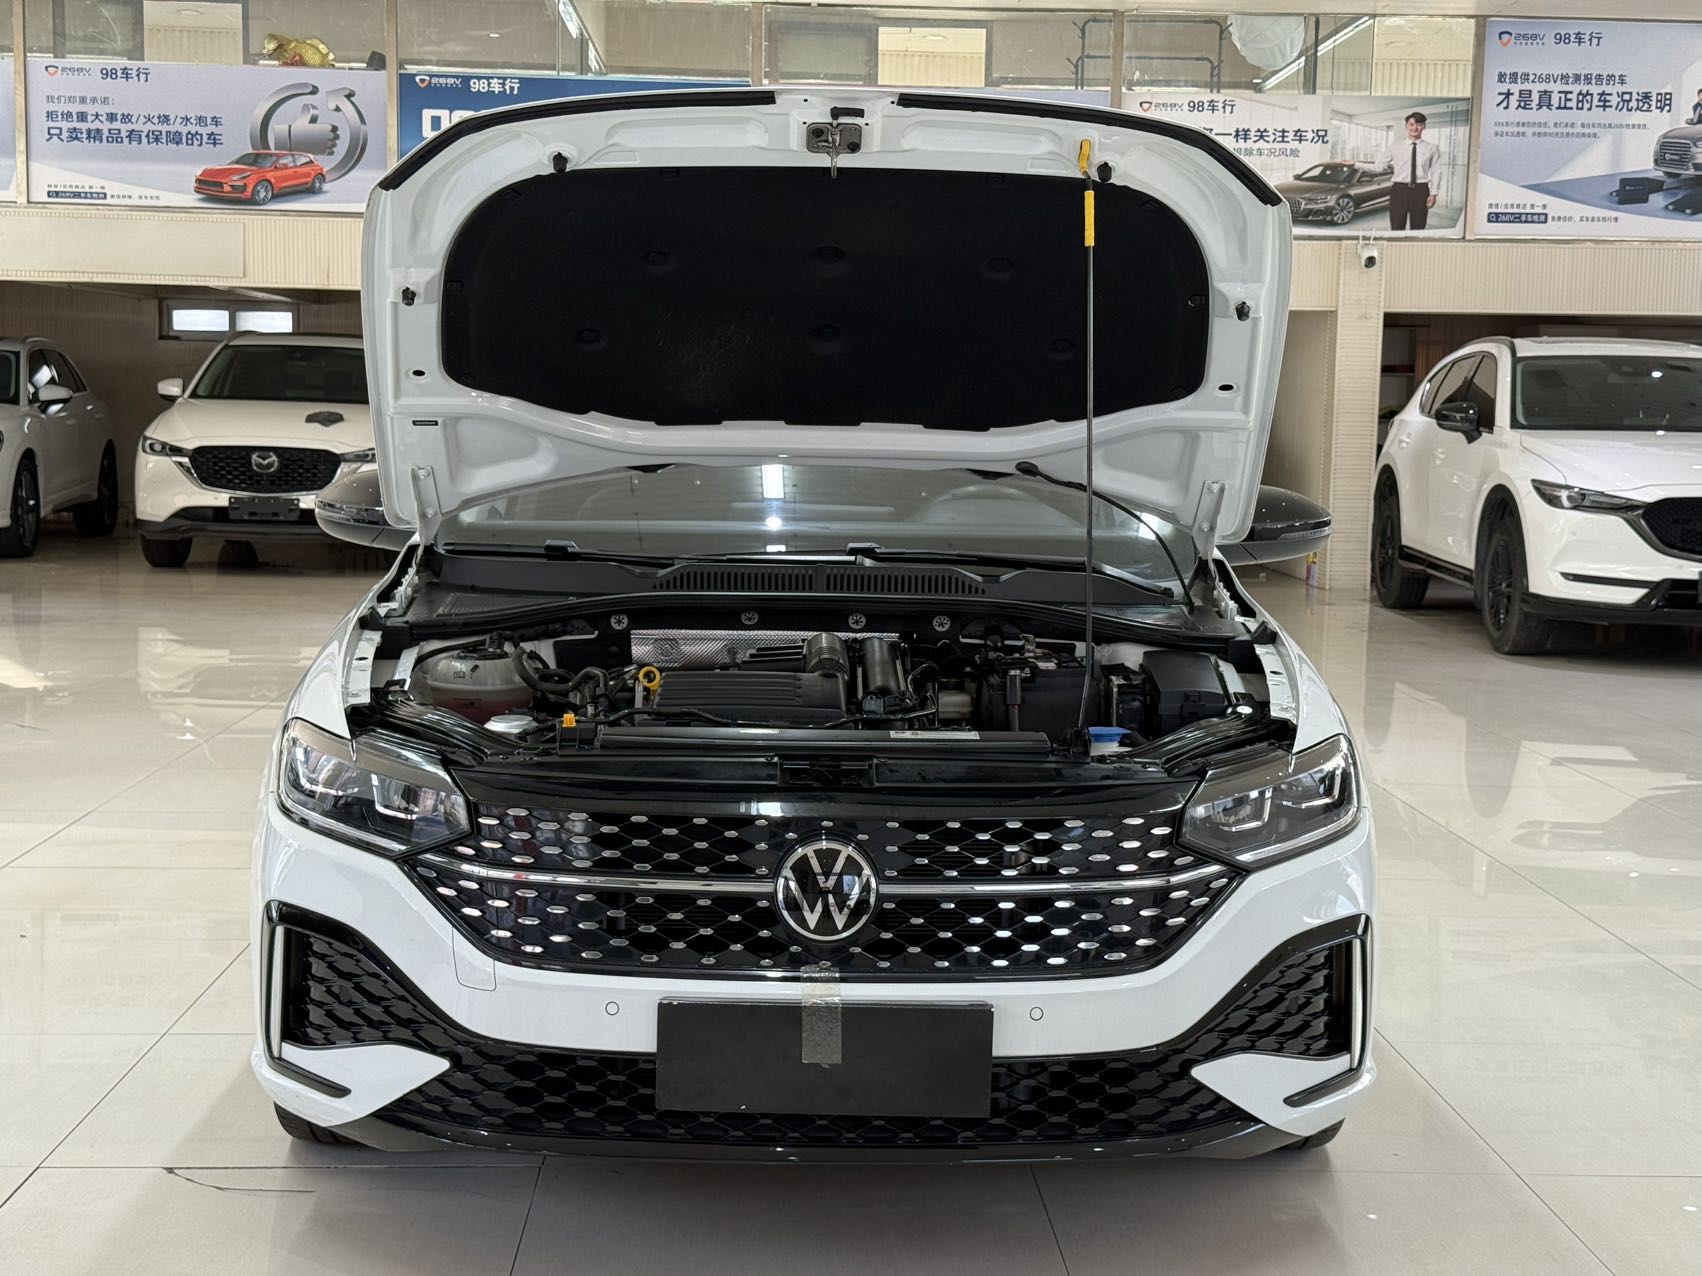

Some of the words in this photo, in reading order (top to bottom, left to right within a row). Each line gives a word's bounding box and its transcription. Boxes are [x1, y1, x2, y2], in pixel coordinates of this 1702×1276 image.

[1514, 33, 1546, 41] 268V
[1554, 31, 1603, 47] 98车行
[100, 66, 151, 83] 98车行
[1496, 71, 1628, 86] 敢提供268V检测报告的车
[470, 78, 520, 95] 98车行
[1187, 99, 1236, 115] 98车行
[1495, 88, 1673, 114] 才是真正的车况透明
[45, 110, 224, 127] 拒绝重大事故/火烧/水泡车
[45, 127, 224, 148] 只卖精品有保障的车
[1497, 214, 1547, 223] 268V二手车检测
